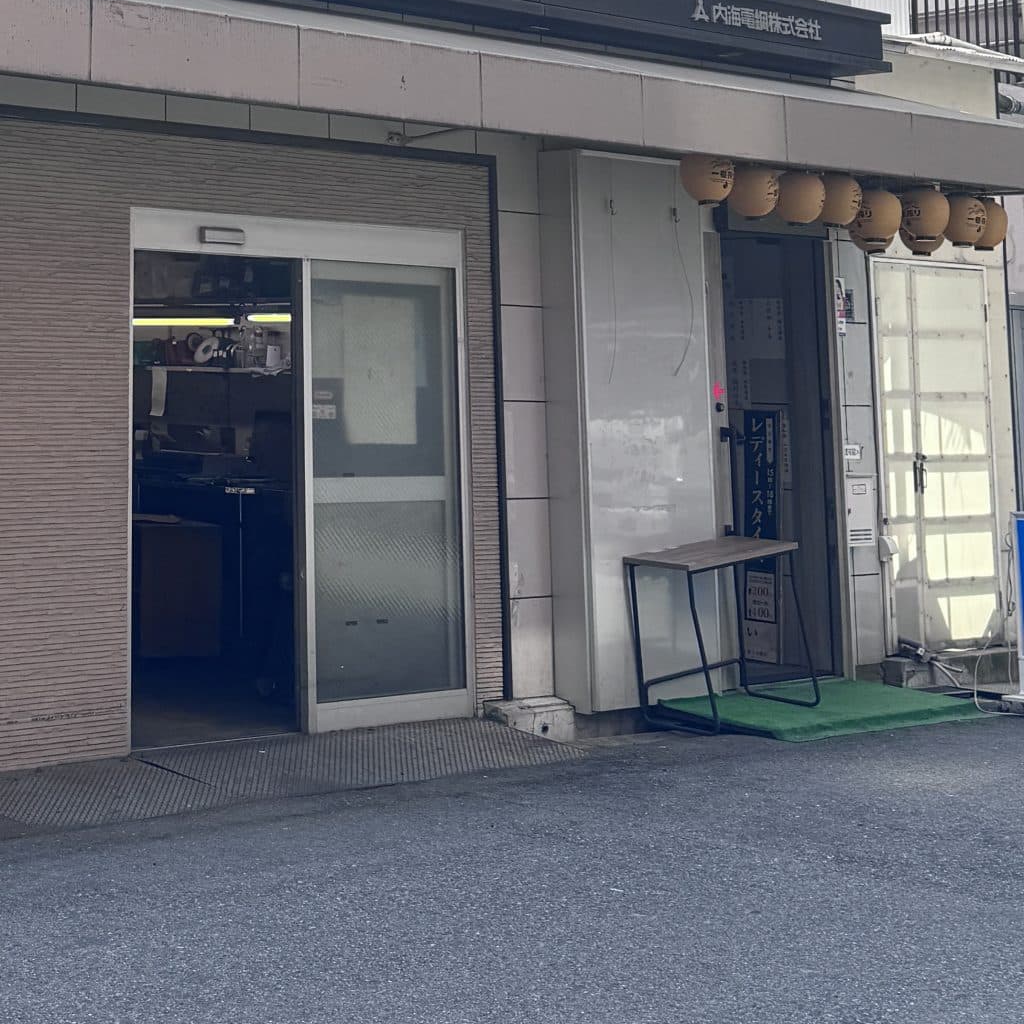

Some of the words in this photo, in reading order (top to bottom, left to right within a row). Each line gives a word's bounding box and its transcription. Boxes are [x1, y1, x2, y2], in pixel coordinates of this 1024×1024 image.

[750, 418, 764, 540] レディースタイ
